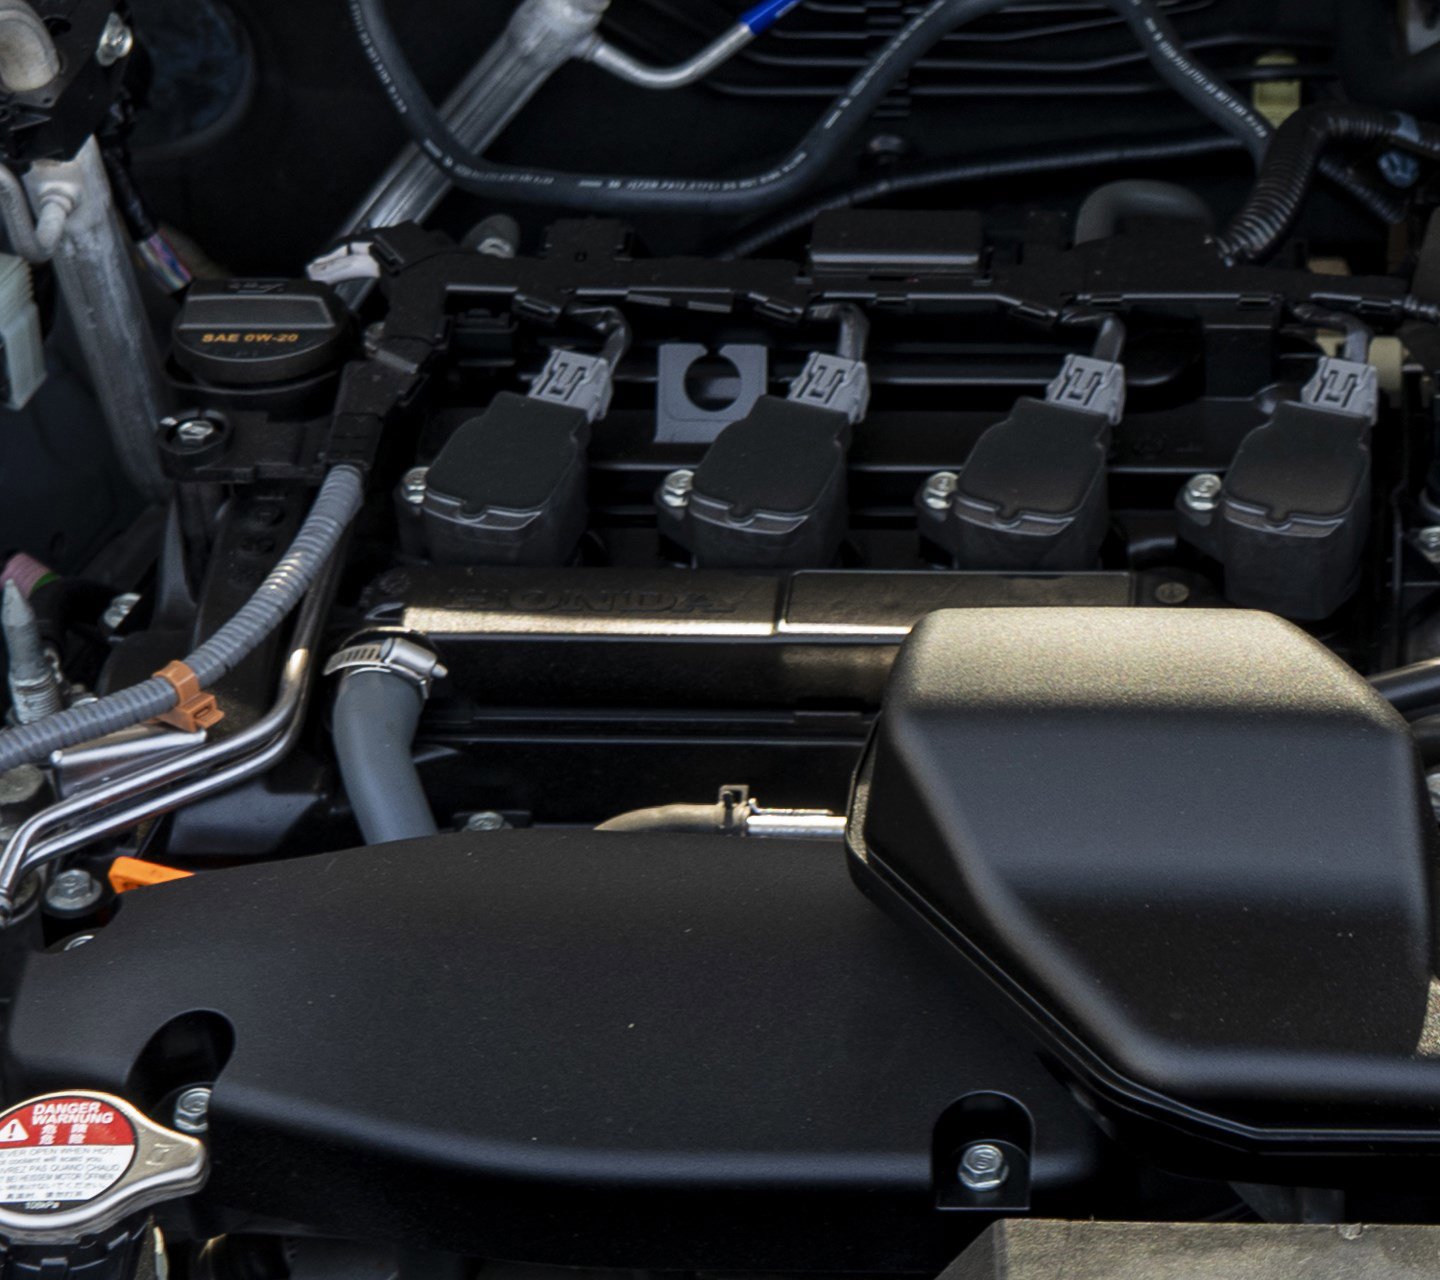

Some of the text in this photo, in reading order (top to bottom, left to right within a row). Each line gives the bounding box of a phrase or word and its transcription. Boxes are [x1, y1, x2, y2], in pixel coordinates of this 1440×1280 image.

[202, 333, 299, 342] SAE 0W-20
[442, 587, 742, 614] HONDA
[34, 1102, 101, 1115] DANGER
[32, 1112, 114, 1125] WARNUNG
